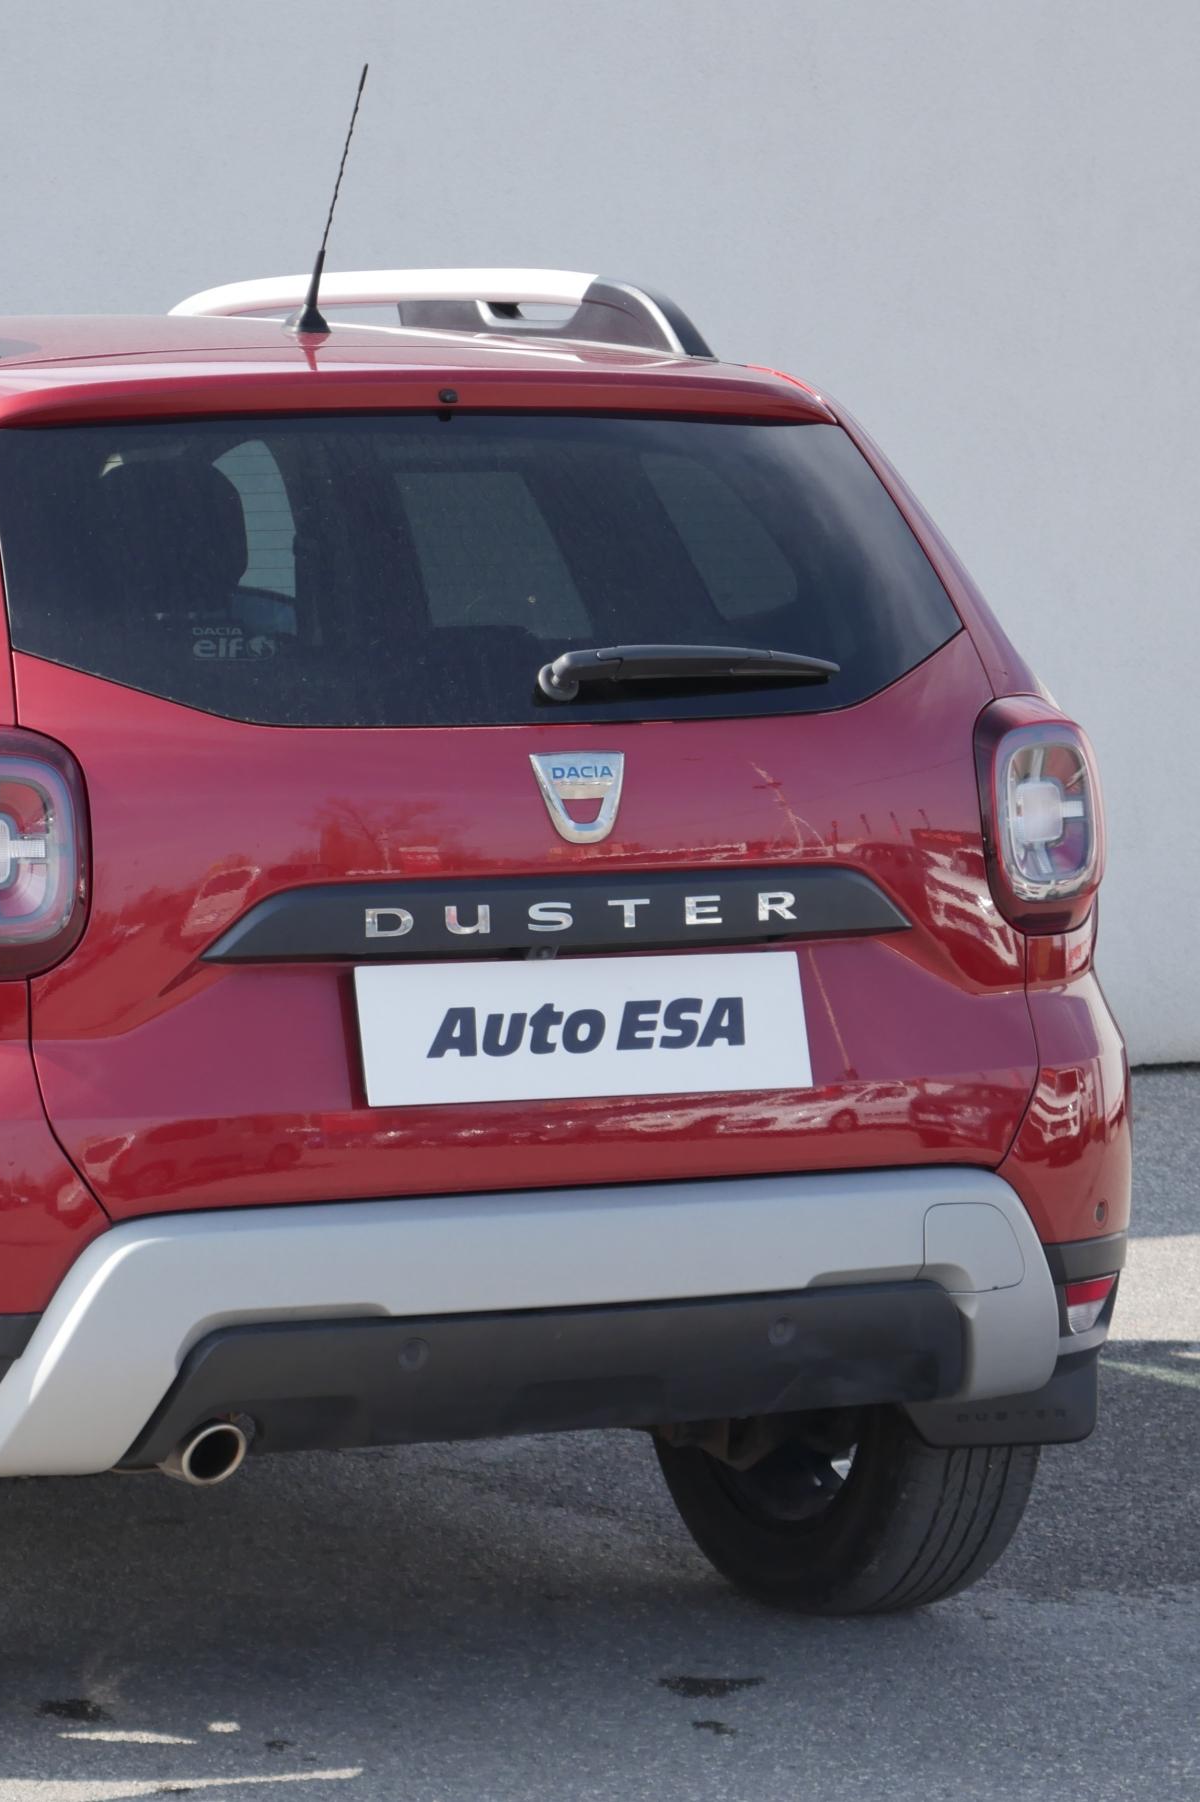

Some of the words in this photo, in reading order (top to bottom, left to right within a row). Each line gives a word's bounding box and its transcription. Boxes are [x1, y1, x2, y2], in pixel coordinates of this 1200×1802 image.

[191, 626, 243, 637] DACIA
[192, 637, 244, 658] elf
[551, 765, 614, 779] DACIA
[365, 890, 798, 939] DUSTER
[426, 1002, 607, 1059] Auto
[615, 996, 746, 1051] ESA
